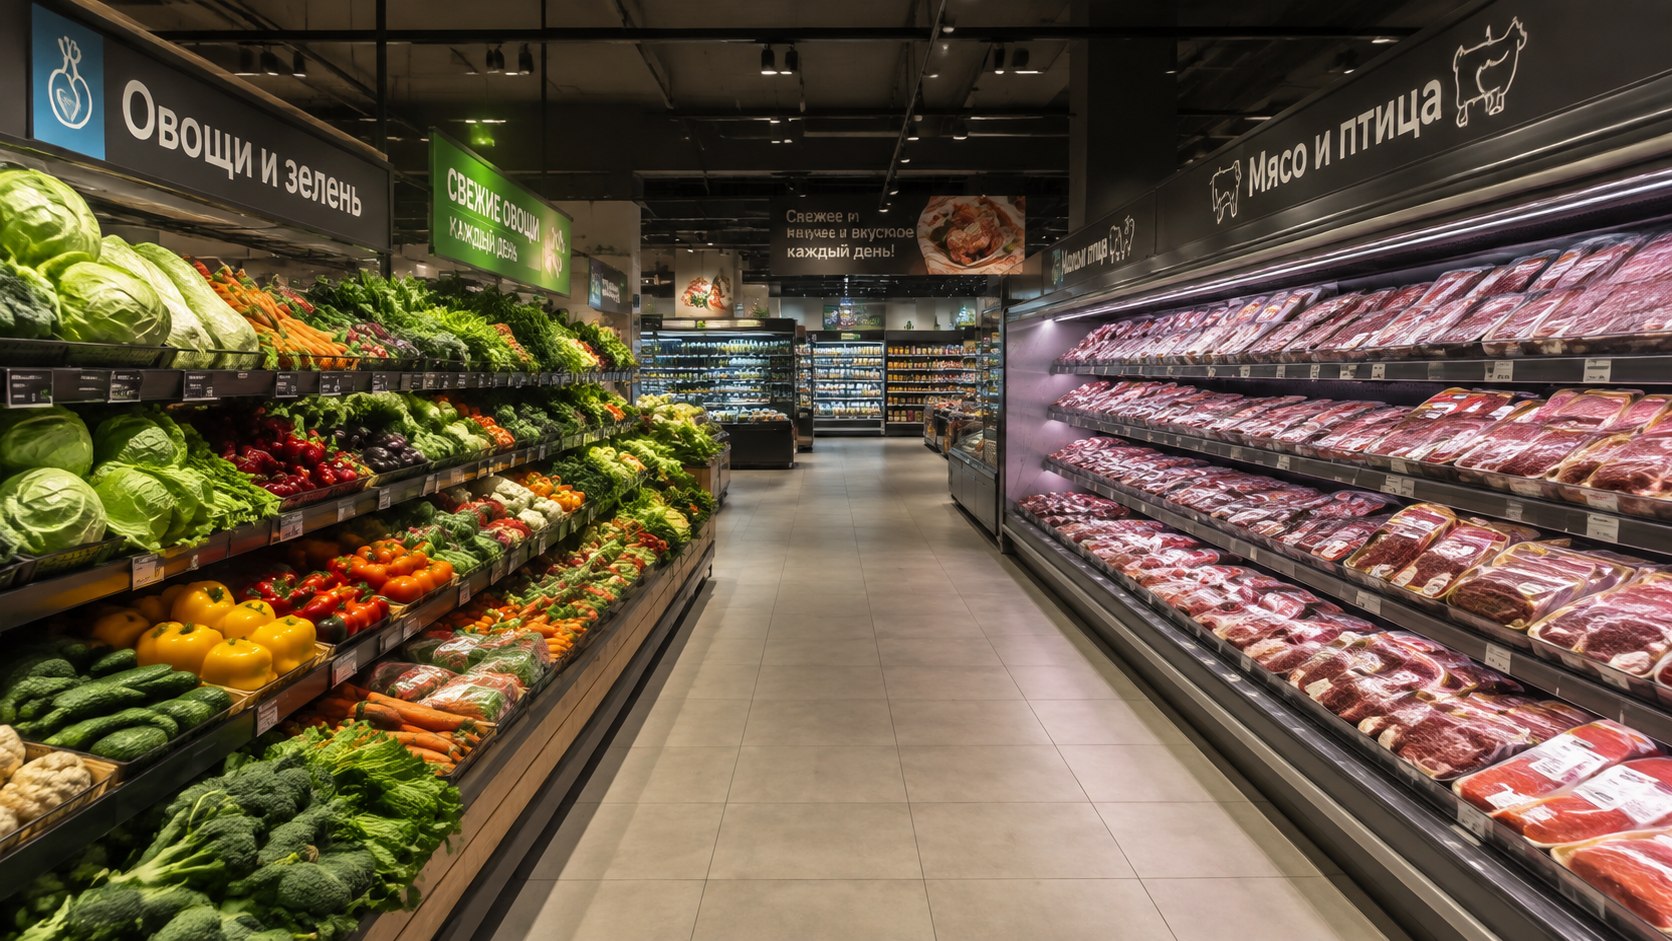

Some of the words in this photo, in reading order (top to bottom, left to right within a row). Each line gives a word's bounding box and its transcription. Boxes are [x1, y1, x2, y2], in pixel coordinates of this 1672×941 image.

[122, 79, 252, 180] Овощи
[261, 147, 278, 188] и
[285, 159, 362, 217] зелень
[1248, 142, 1307, 198] Мясо
[1315, 129, 1331, 170] и
[1339, 79, 1442, 160] птица
[447, 168, 501, 223] СВЕЖИЕ
[503, 200, 540, 244] ОВОЩИ
[787, 244, 850, 260] каждый
[853, 244, 895, 260] день!
